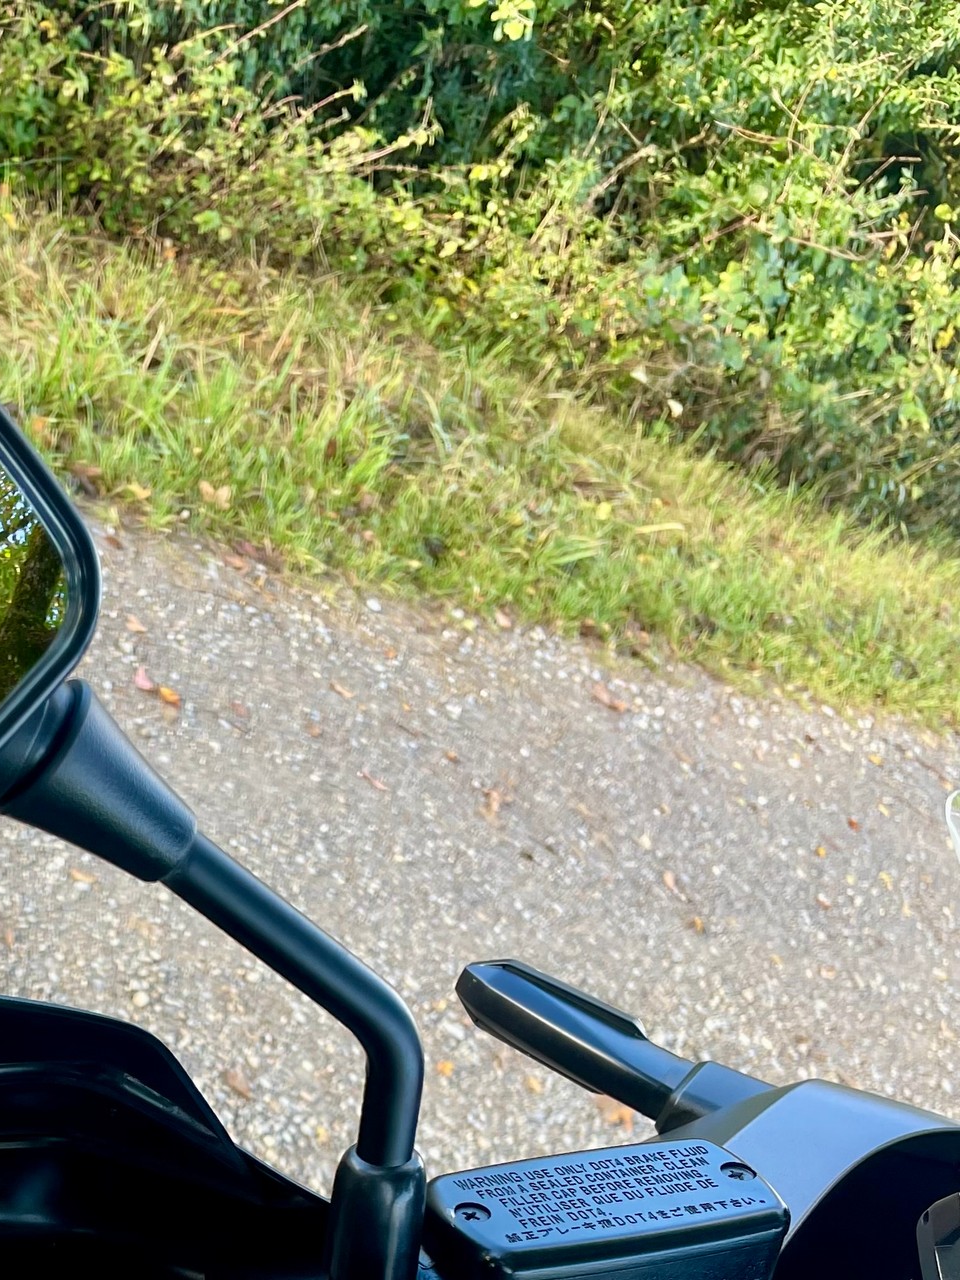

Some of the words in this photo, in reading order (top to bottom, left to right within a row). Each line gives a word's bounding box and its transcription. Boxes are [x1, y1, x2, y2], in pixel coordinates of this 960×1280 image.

[453, 1172, 524, 1190] WARNING
[523, 1168, 554, 1180] USE
[554, 1163, 587, 1176] ONLY
[588, 1158, 624, 1171] DOT4
[623, 1151, 670, 1166] BRAKE
[668, 1145, 709, 1158] FLUID
[475, 1185, 517, 1199] FROM
[517, 1184, 529, 1194] A
[528, 1175, 584, 1191] SEALED
[585, 1164, 664, 1183] CONTAINER.
[662, 1156, 710, 1171] CLEAN
[498, 1192, 551, 1208] FILLER
[551, 1187, 577, 1200] CAP
[579, 1179, 636, 1195] BEFORE
[634, 1169, 708, 1187] REMOVING.
[508, 1198, 591, 1218] N'UTILISER
[592, 1193, 623, 1205] QUE
[622, 1189, 645, 1201] DU
[644, 1181, 697, 1197] FLUIDE
[696, 1178, 719, 1189] DE
[519, 1213, 565, 1229] FREIN
[566, 1207, 613, 1222] DOT4.
